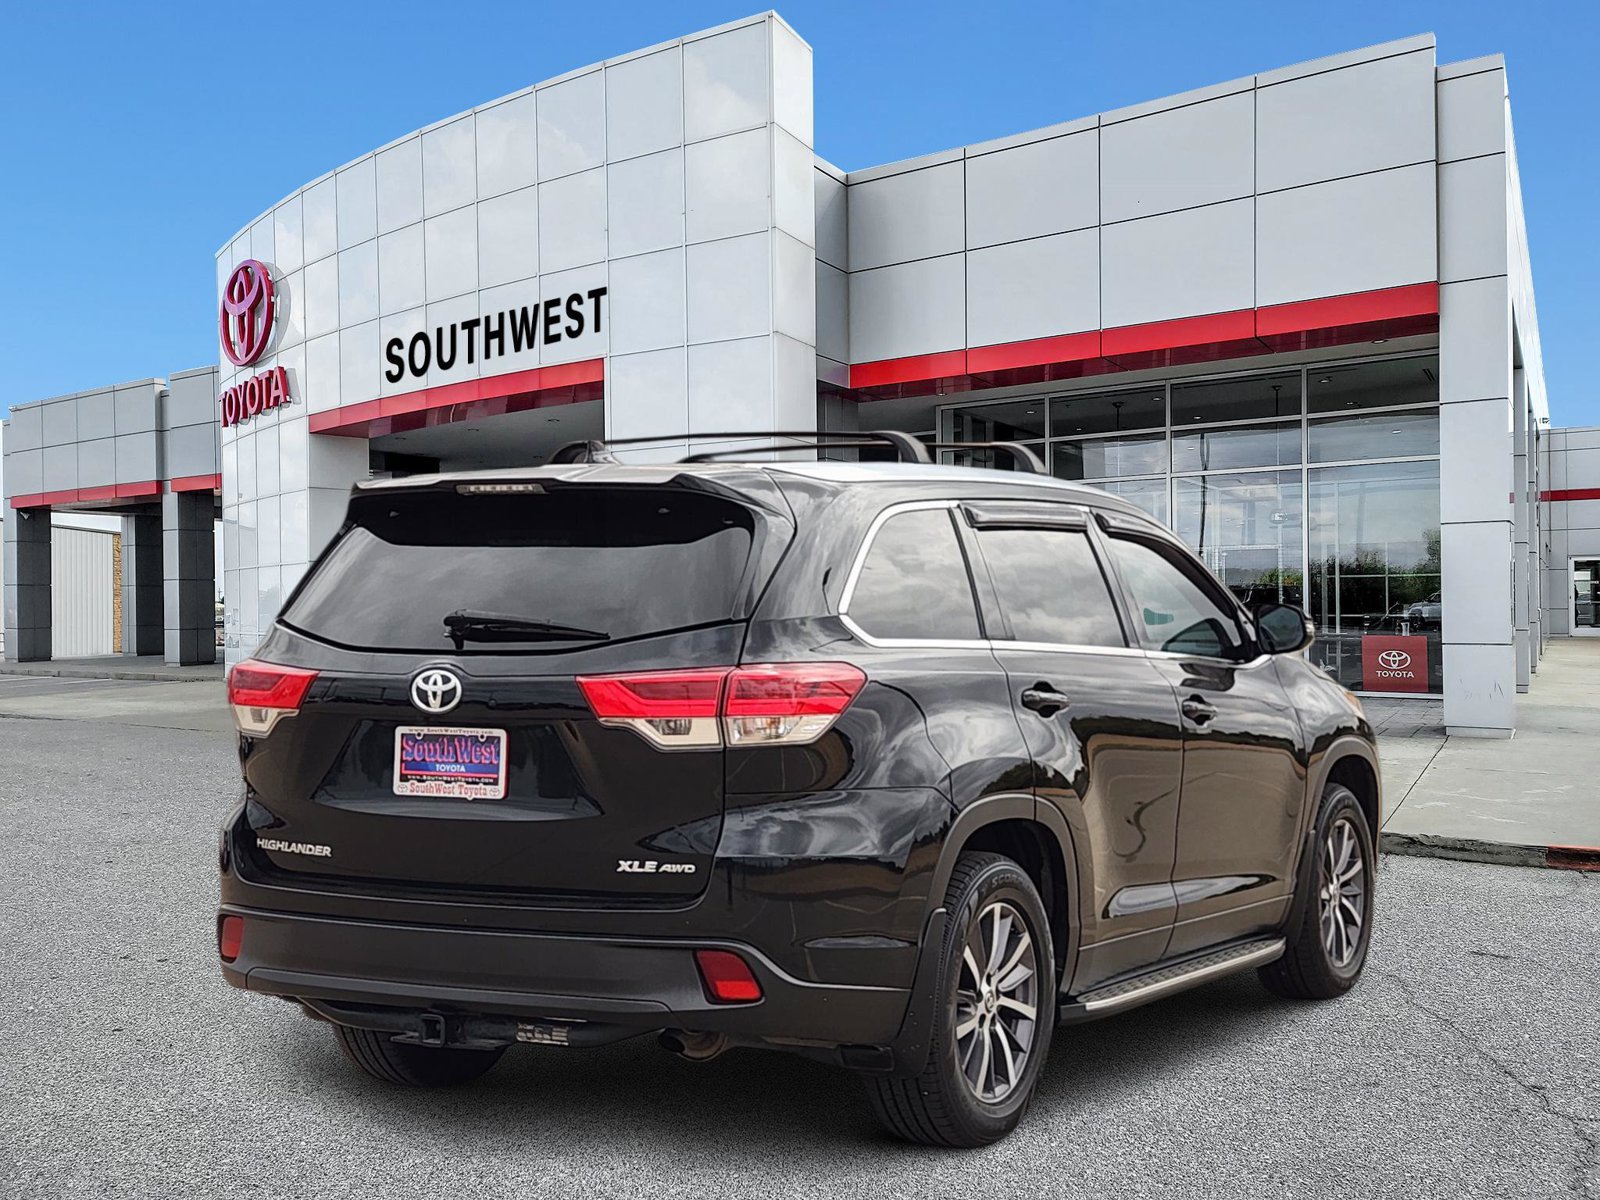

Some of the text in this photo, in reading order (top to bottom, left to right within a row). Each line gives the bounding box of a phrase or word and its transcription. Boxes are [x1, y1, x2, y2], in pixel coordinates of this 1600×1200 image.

[385, 286, 608, 384] SOUTHWEST
[218, 366, 289, 428] TOYOTA
[1375, 670, 1415, 678] TOYOTA
[435, 764, 466, 773] TOYOTA
[409, 782, 487, 798] SouthWest Toyota
[256, 838, 332, 857] HIGHLANDER
[616, 860, 696, 873] XLE AWD
